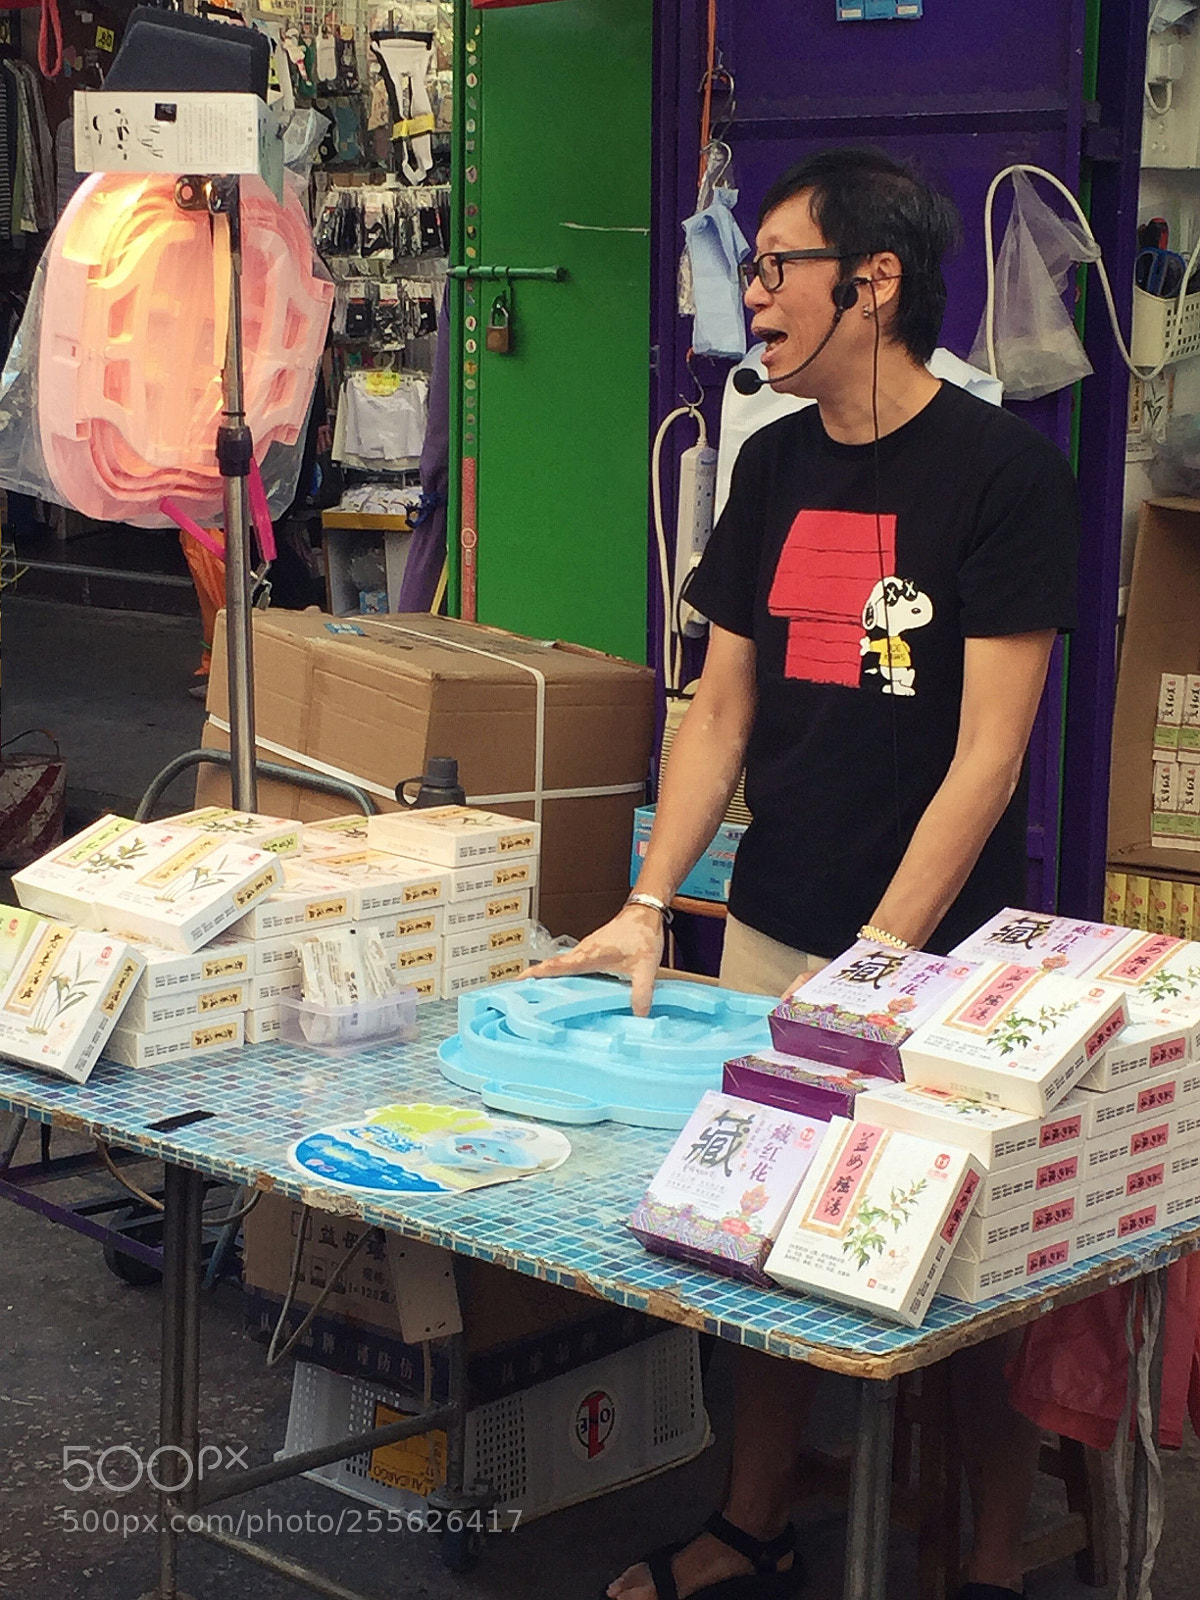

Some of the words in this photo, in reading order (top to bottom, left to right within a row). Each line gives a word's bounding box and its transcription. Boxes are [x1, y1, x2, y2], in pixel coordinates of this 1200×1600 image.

[984, 916, 1054, 950] 藏
[830, 951, 908, 990] 藏
[684, 1109, 755, 1178] 藏
[750, 1123, 796, 1183] 藏红花
[373, 1465, 409, 1486] CARGO
